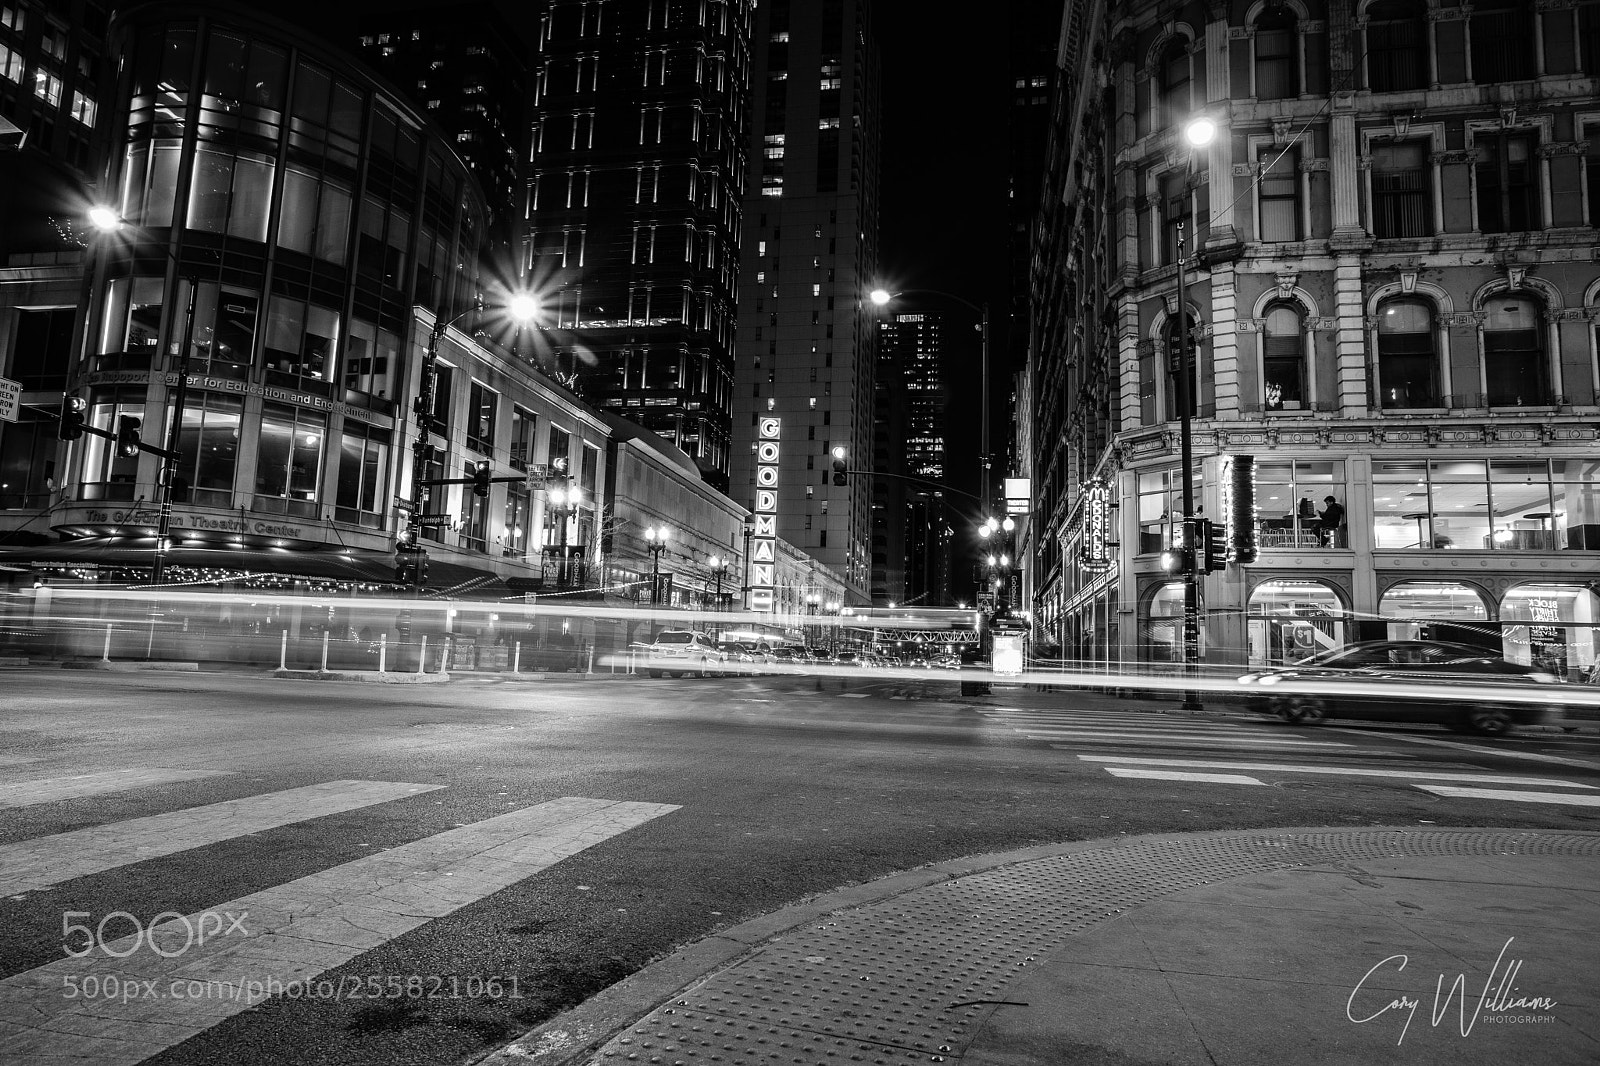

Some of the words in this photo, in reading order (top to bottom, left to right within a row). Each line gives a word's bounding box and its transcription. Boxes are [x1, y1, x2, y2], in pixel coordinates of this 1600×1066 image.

[155, 373, 199, 385] Cener
[203, 376, 222, 388] for
[226, 380, 287, 400] Education
[290, 392, 311, 404] and
[314, 398, 373, 421] Engagement
[755, 418, 780, 586] GOODMAN
[86, 509, 108, 523] The
[189, 515, 249, 532] Theatre
[254, 523, 301, 538] Center
[1297, 629, 1313, 644] $1
